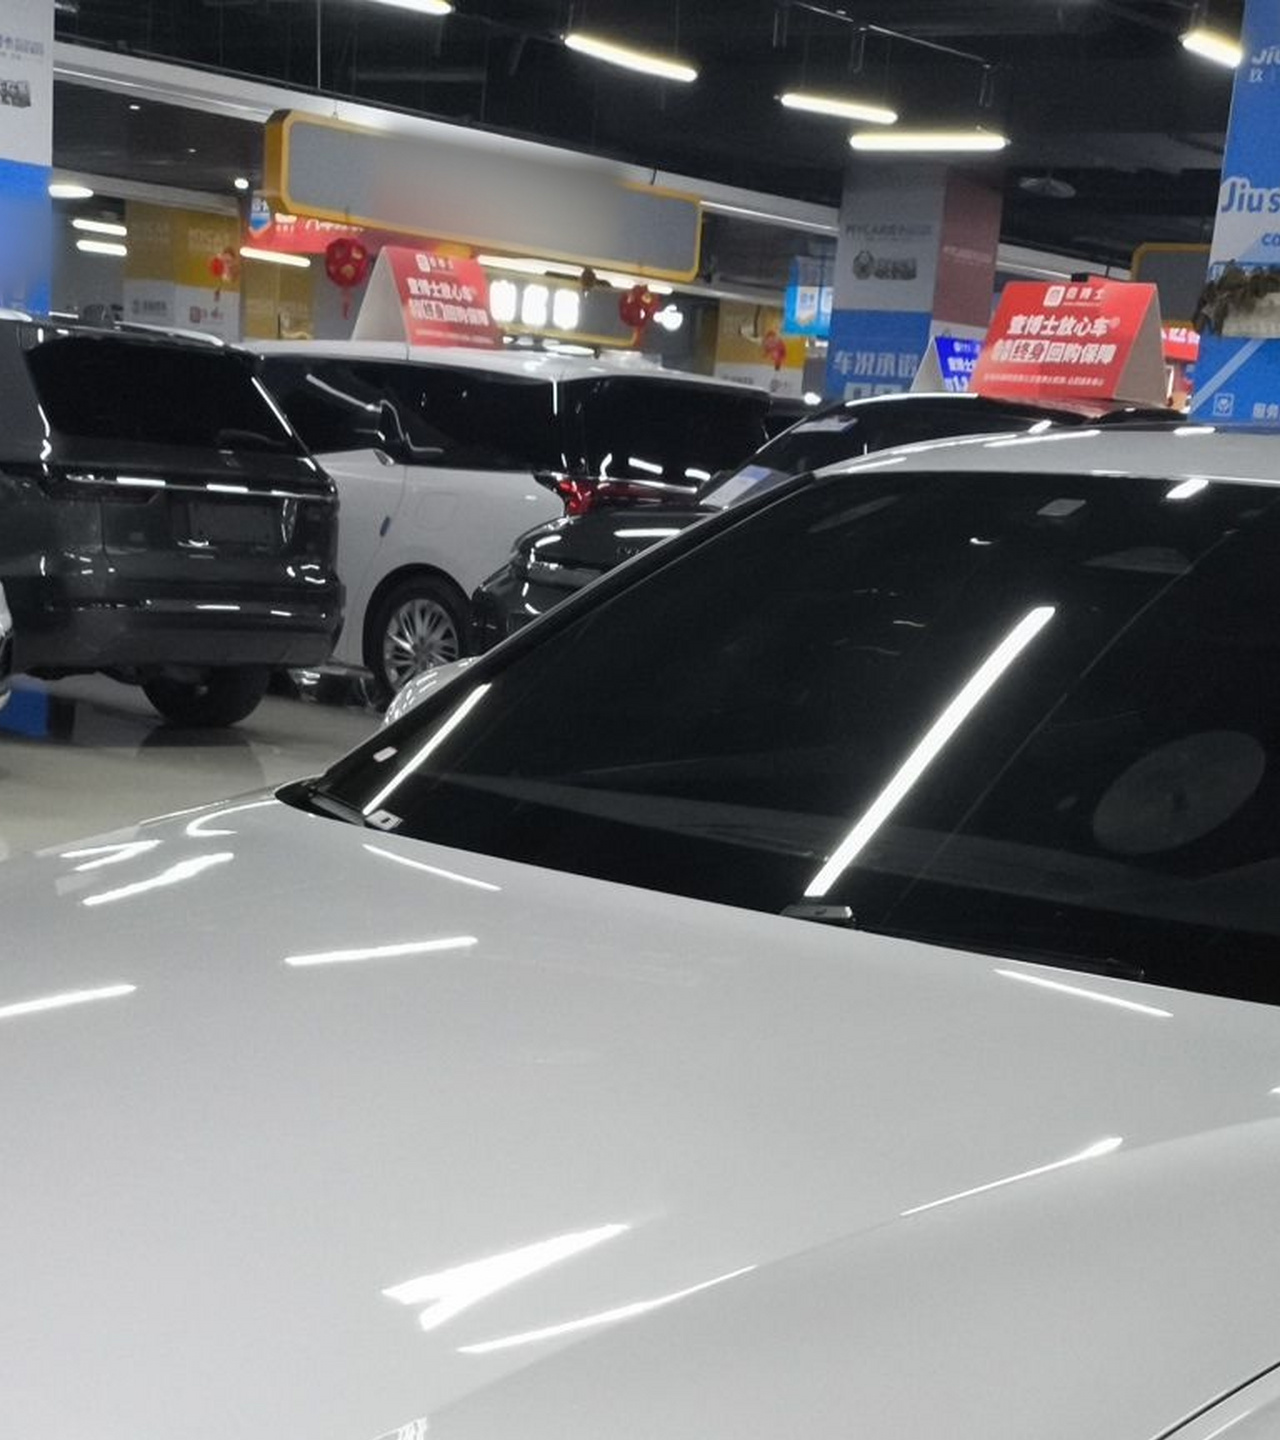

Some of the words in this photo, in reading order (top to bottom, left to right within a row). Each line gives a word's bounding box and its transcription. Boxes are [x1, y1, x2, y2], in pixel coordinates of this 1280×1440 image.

[1007, 314, 1109, 337] 查博士放心车
